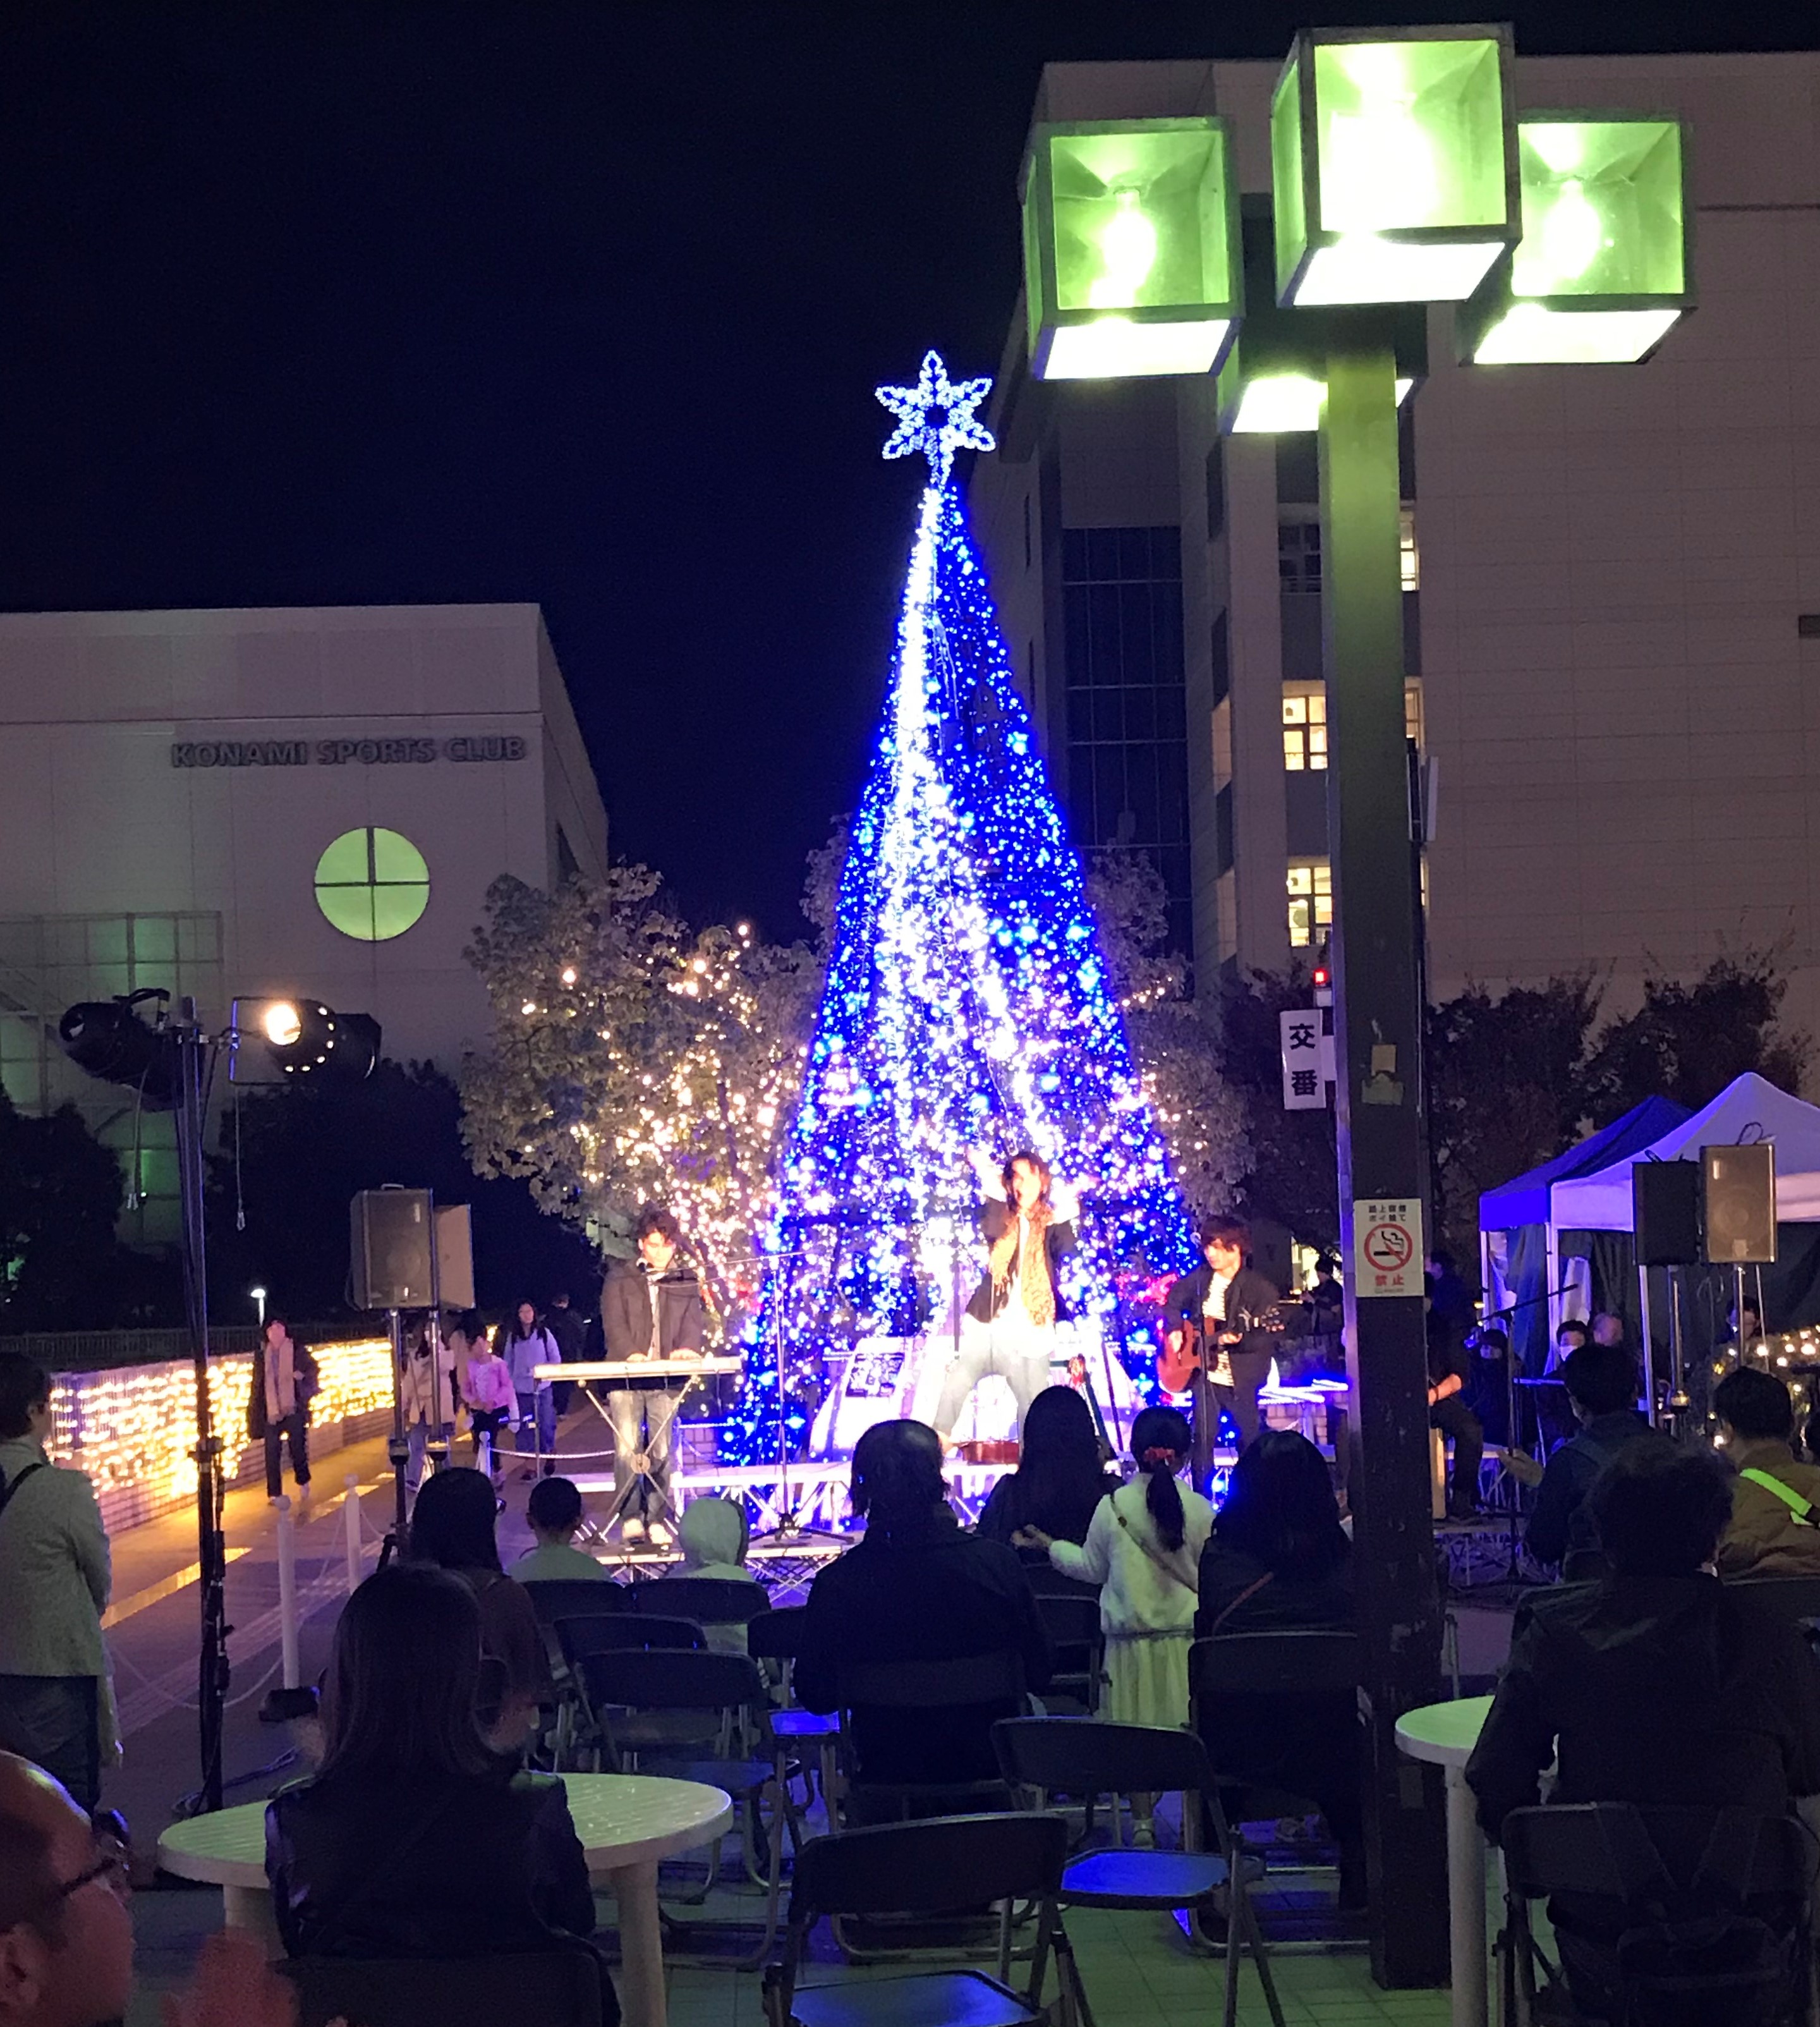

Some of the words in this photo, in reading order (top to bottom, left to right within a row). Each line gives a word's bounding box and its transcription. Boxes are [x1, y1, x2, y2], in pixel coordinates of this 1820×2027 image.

[171, 741, 308, 768] KONAMI
[317, 738, 435, 765] SPORTS
[442, 736, 527, 763] CLUB
[1289, 1023, 1318, 1097] 交番
